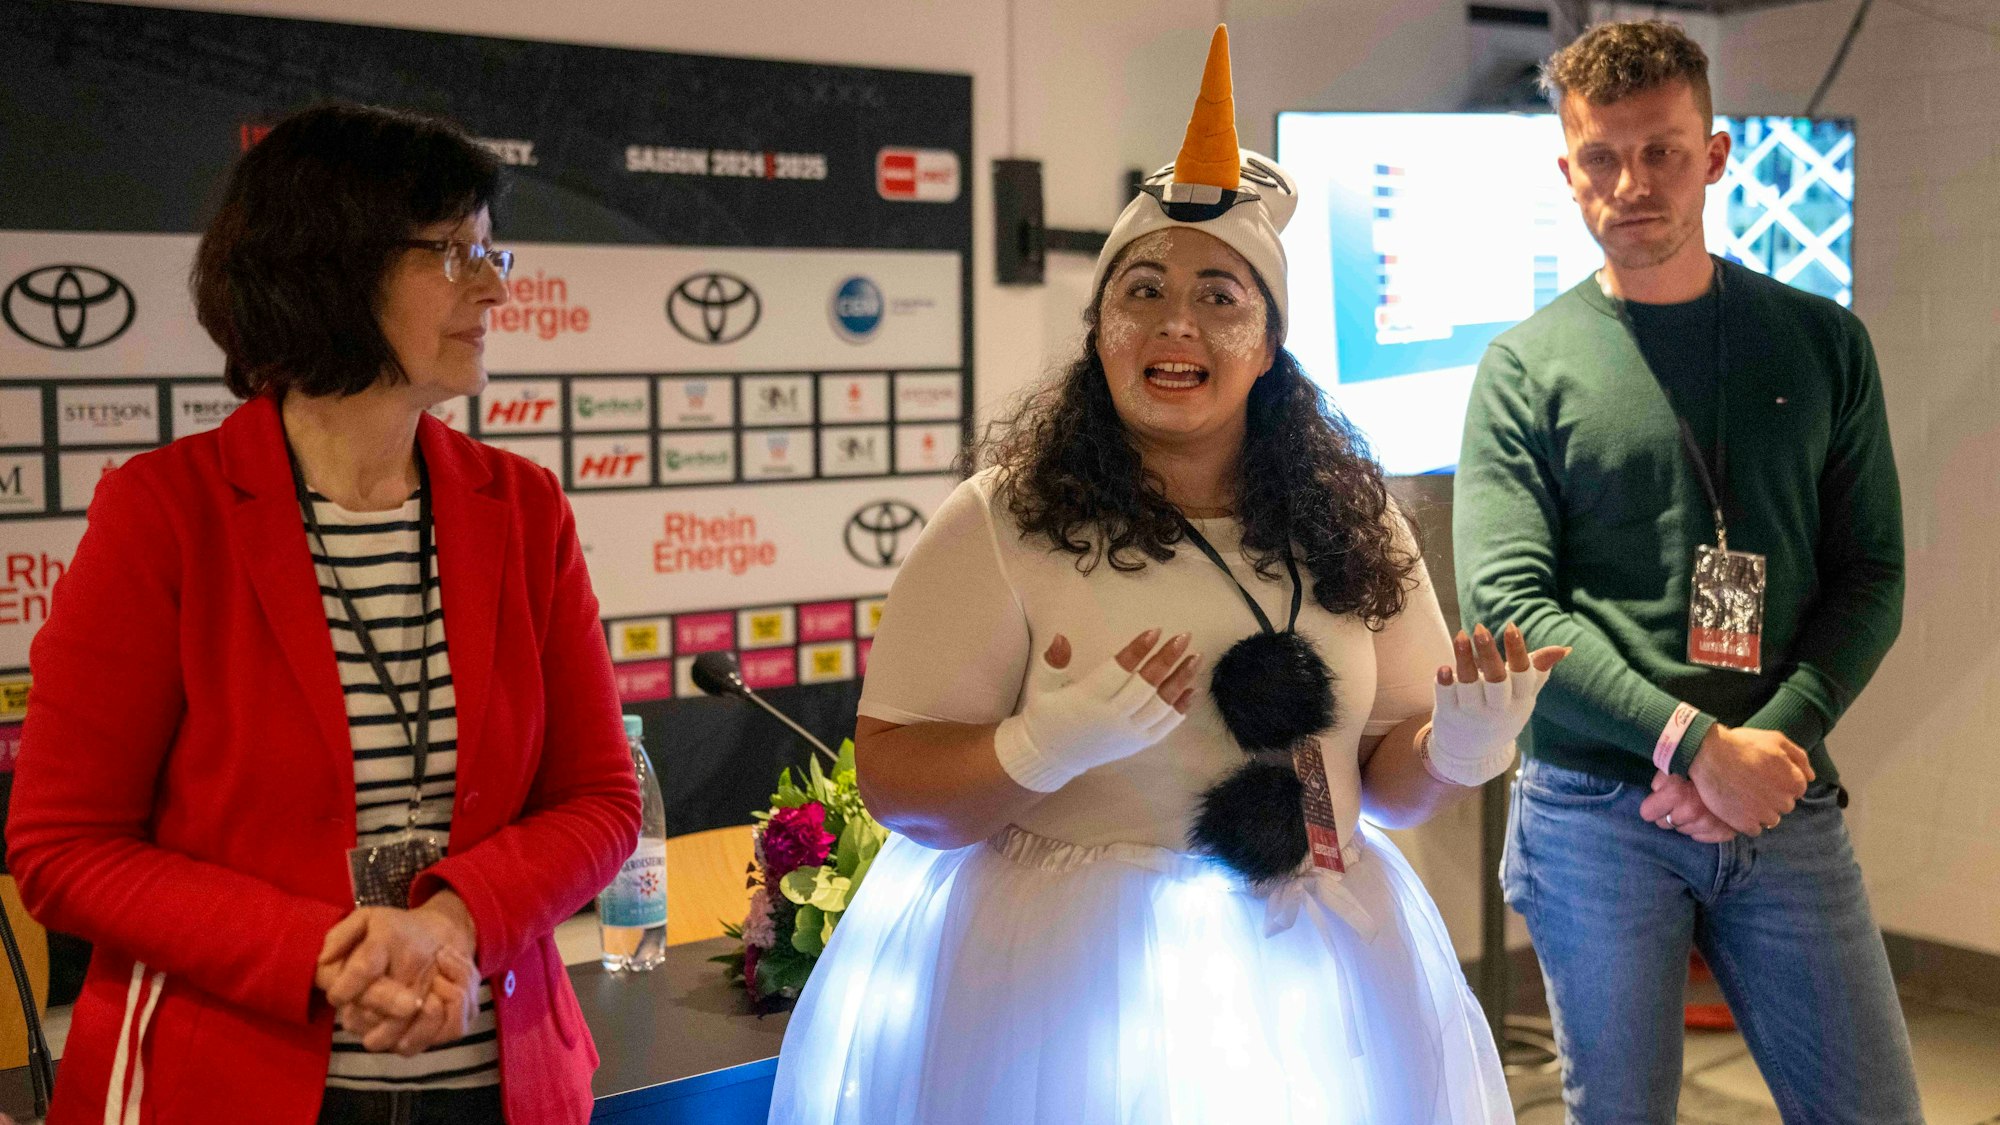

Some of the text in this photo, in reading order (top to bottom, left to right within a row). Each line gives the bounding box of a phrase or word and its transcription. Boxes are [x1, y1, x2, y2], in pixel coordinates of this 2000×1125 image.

[625, 145, 828, 181] SAISON 2024 2025
[507, 268, 568, 304] ein
[64, 402, 151, 422] STETSON
[487, 399, 555, 424] HIT
[579, 453, 645, 479] HIT
[664, 508, 757, 543] Rhein
[6, 552, 65, 589] Rh
[653, 538, 777, 576] Energie
